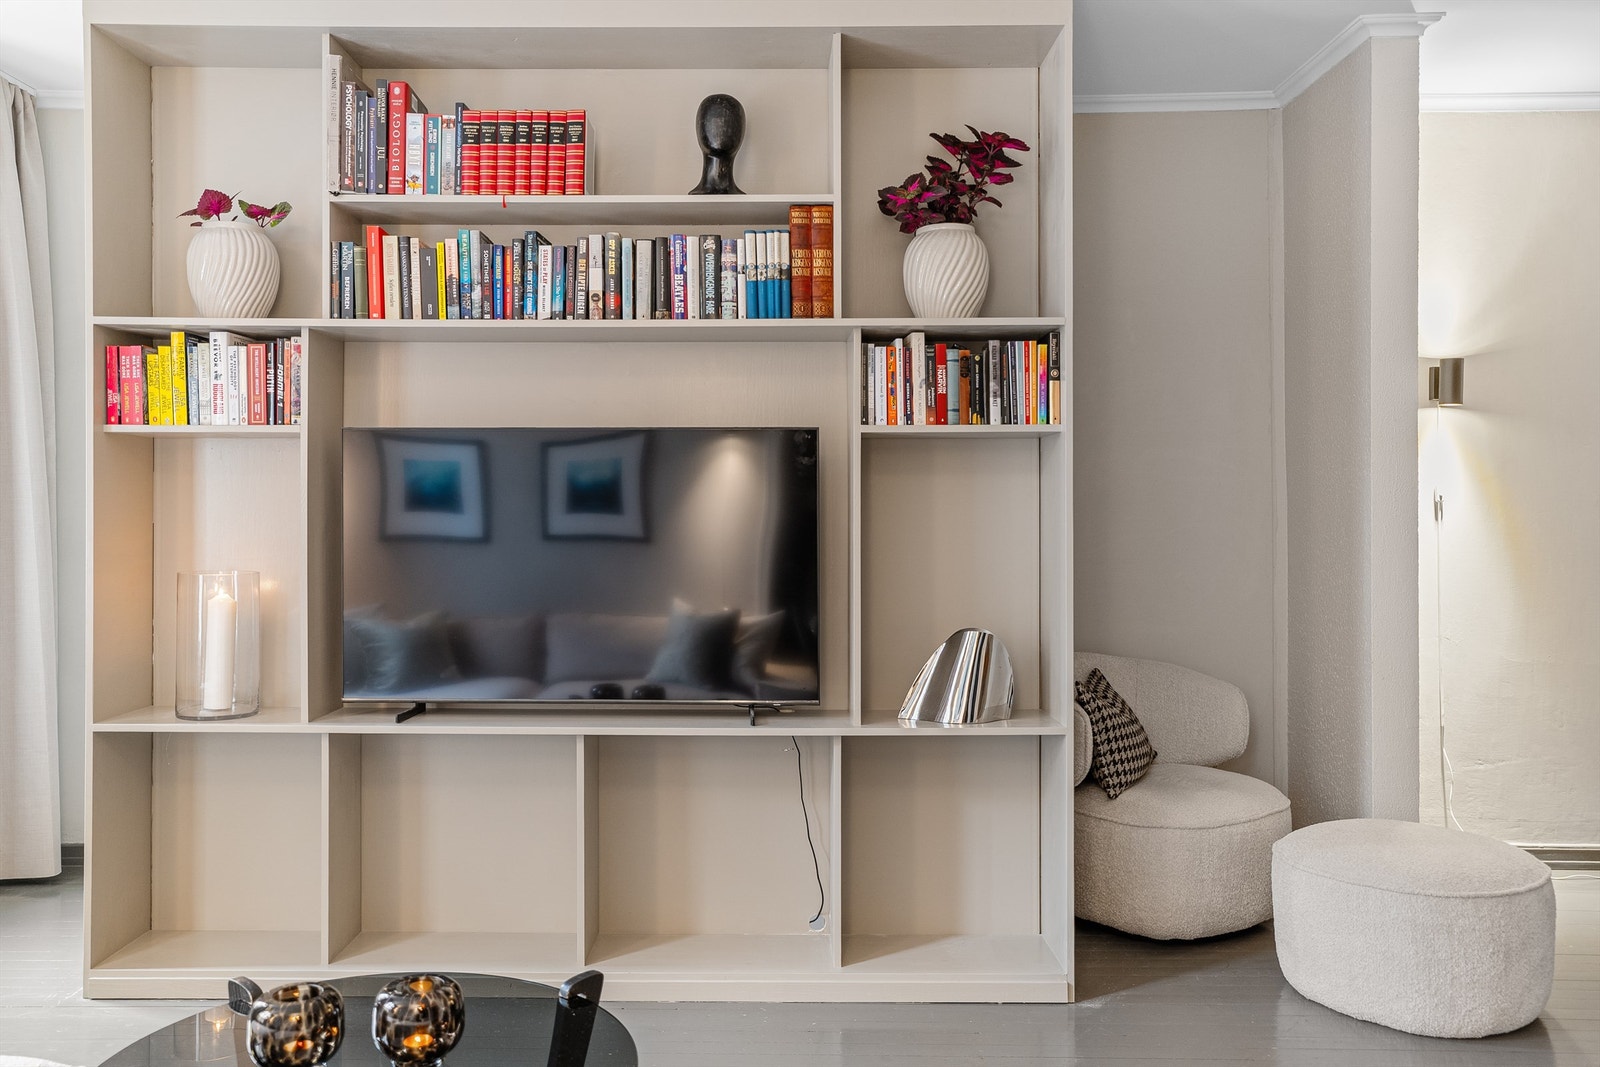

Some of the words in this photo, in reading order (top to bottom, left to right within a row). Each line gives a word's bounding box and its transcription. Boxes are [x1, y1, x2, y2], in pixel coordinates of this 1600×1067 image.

[392, 112, 400, 171] BIOLOGY
[376, 146, 385, 160] JUL
[792, 249, 810, 258] VERDENS
[813, 249, 832, 258] VERDENS
[705, 253, 715, 298] OVERHENGENDE
[577, 291, 586, 314] KRIGEN
[675, 274, 684, 313] BEATLES
[706, 300, 715, 314] FARE
